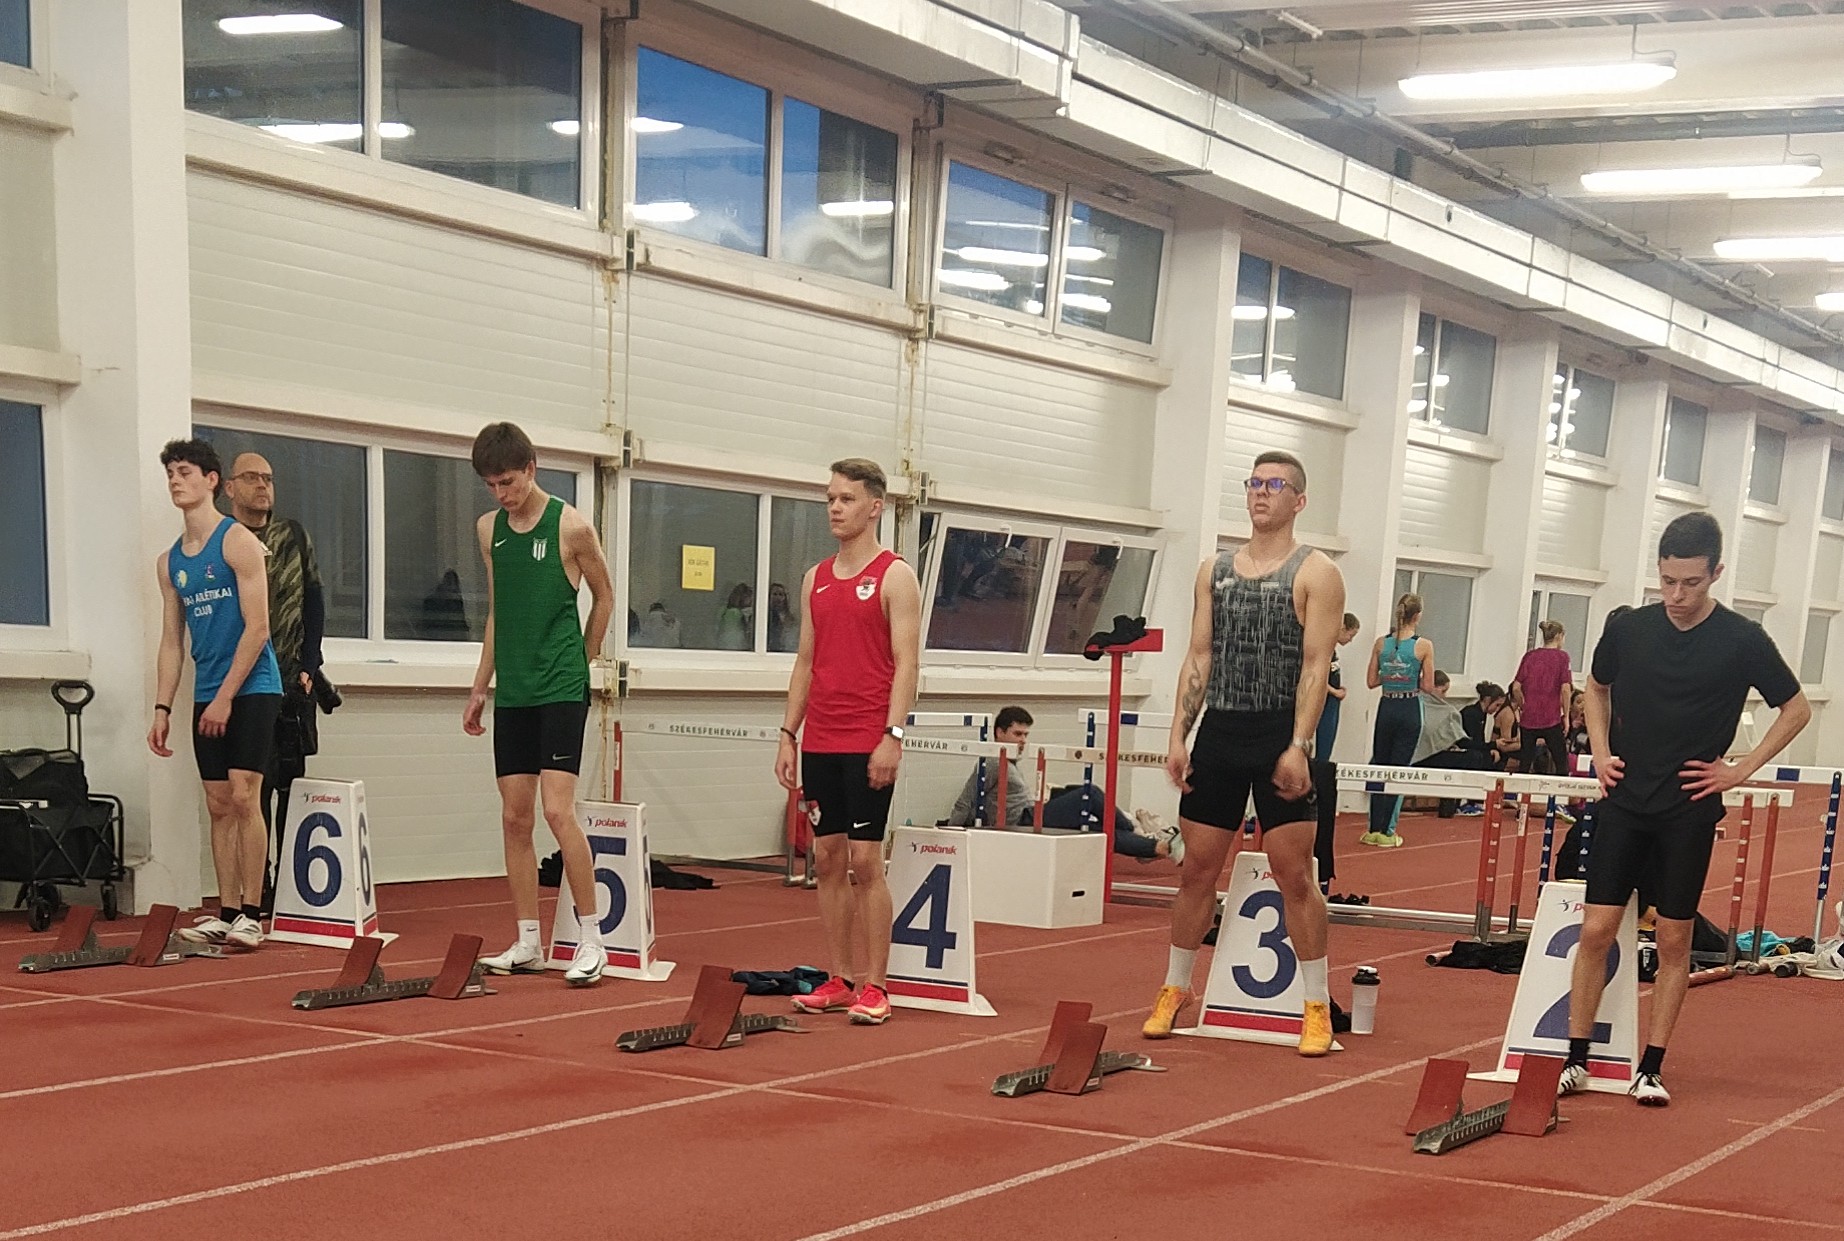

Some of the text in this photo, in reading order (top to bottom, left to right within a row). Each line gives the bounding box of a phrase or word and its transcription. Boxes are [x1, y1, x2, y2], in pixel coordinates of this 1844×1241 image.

[669, 723, 748, 738] SZÉKESFEHÉRVÁR
[293, 811, 343, 908] 6
[358, 812, 371, 907] 6
[594, 817, 628, 828] polanik
[919, 843, 958, 856] polanik
[573, 834, 627, 936] 5
[891, 863, 957, 969] 4
[1231, 889, 1298, 999] 3
[1532, 922, 1621, 1044] 2
